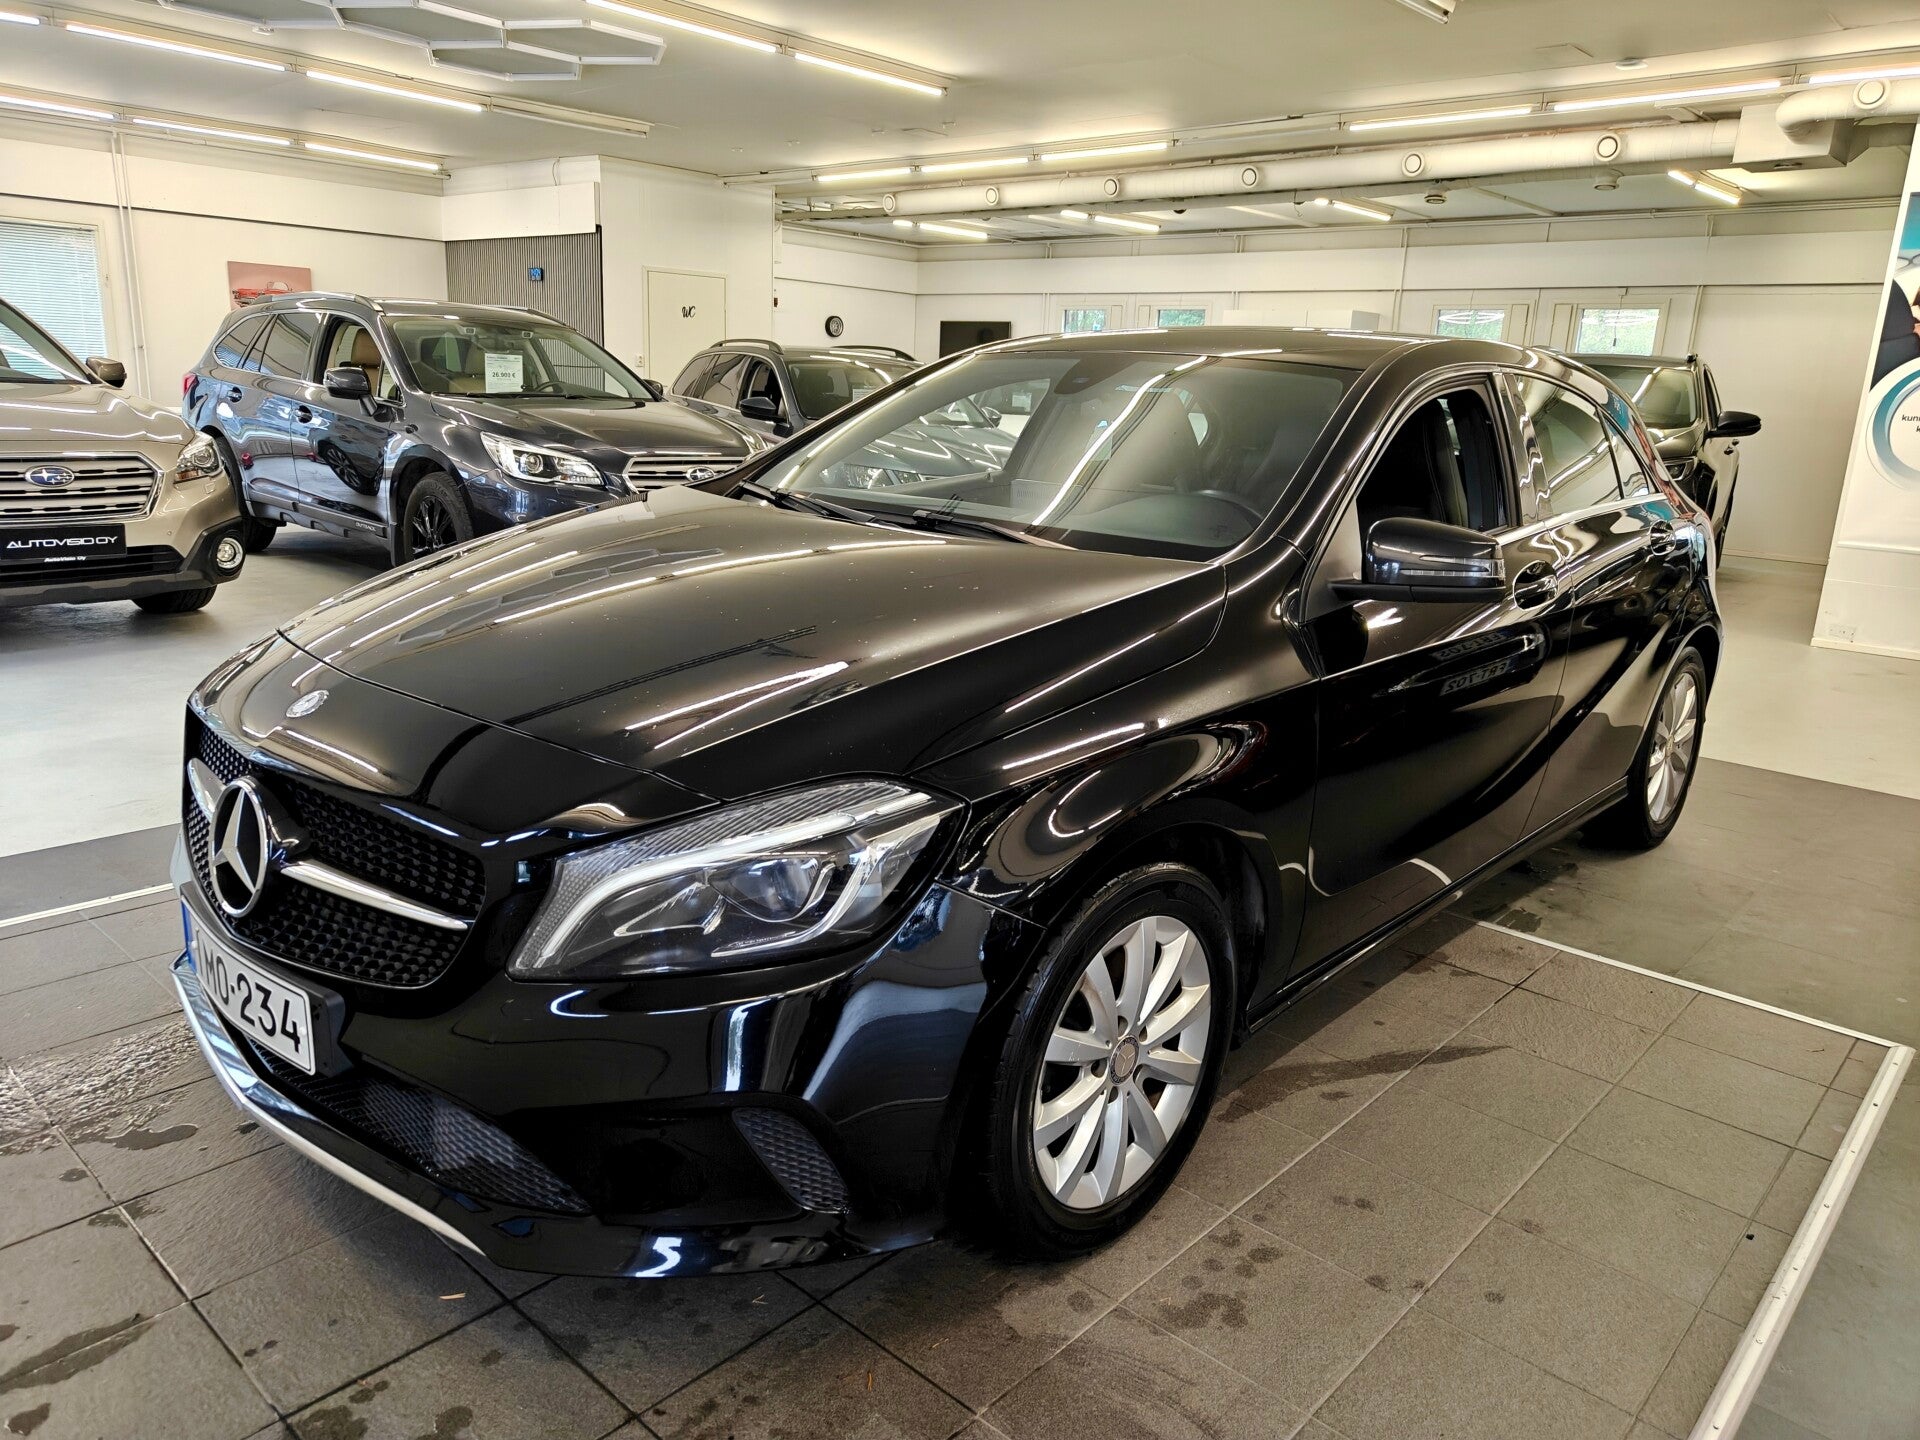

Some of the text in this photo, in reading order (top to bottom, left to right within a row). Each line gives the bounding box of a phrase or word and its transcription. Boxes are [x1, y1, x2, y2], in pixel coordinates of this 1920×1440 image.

[681, 305, 696, 318] WC
[6, 536, 118, 549] AUTOVISIO OY
